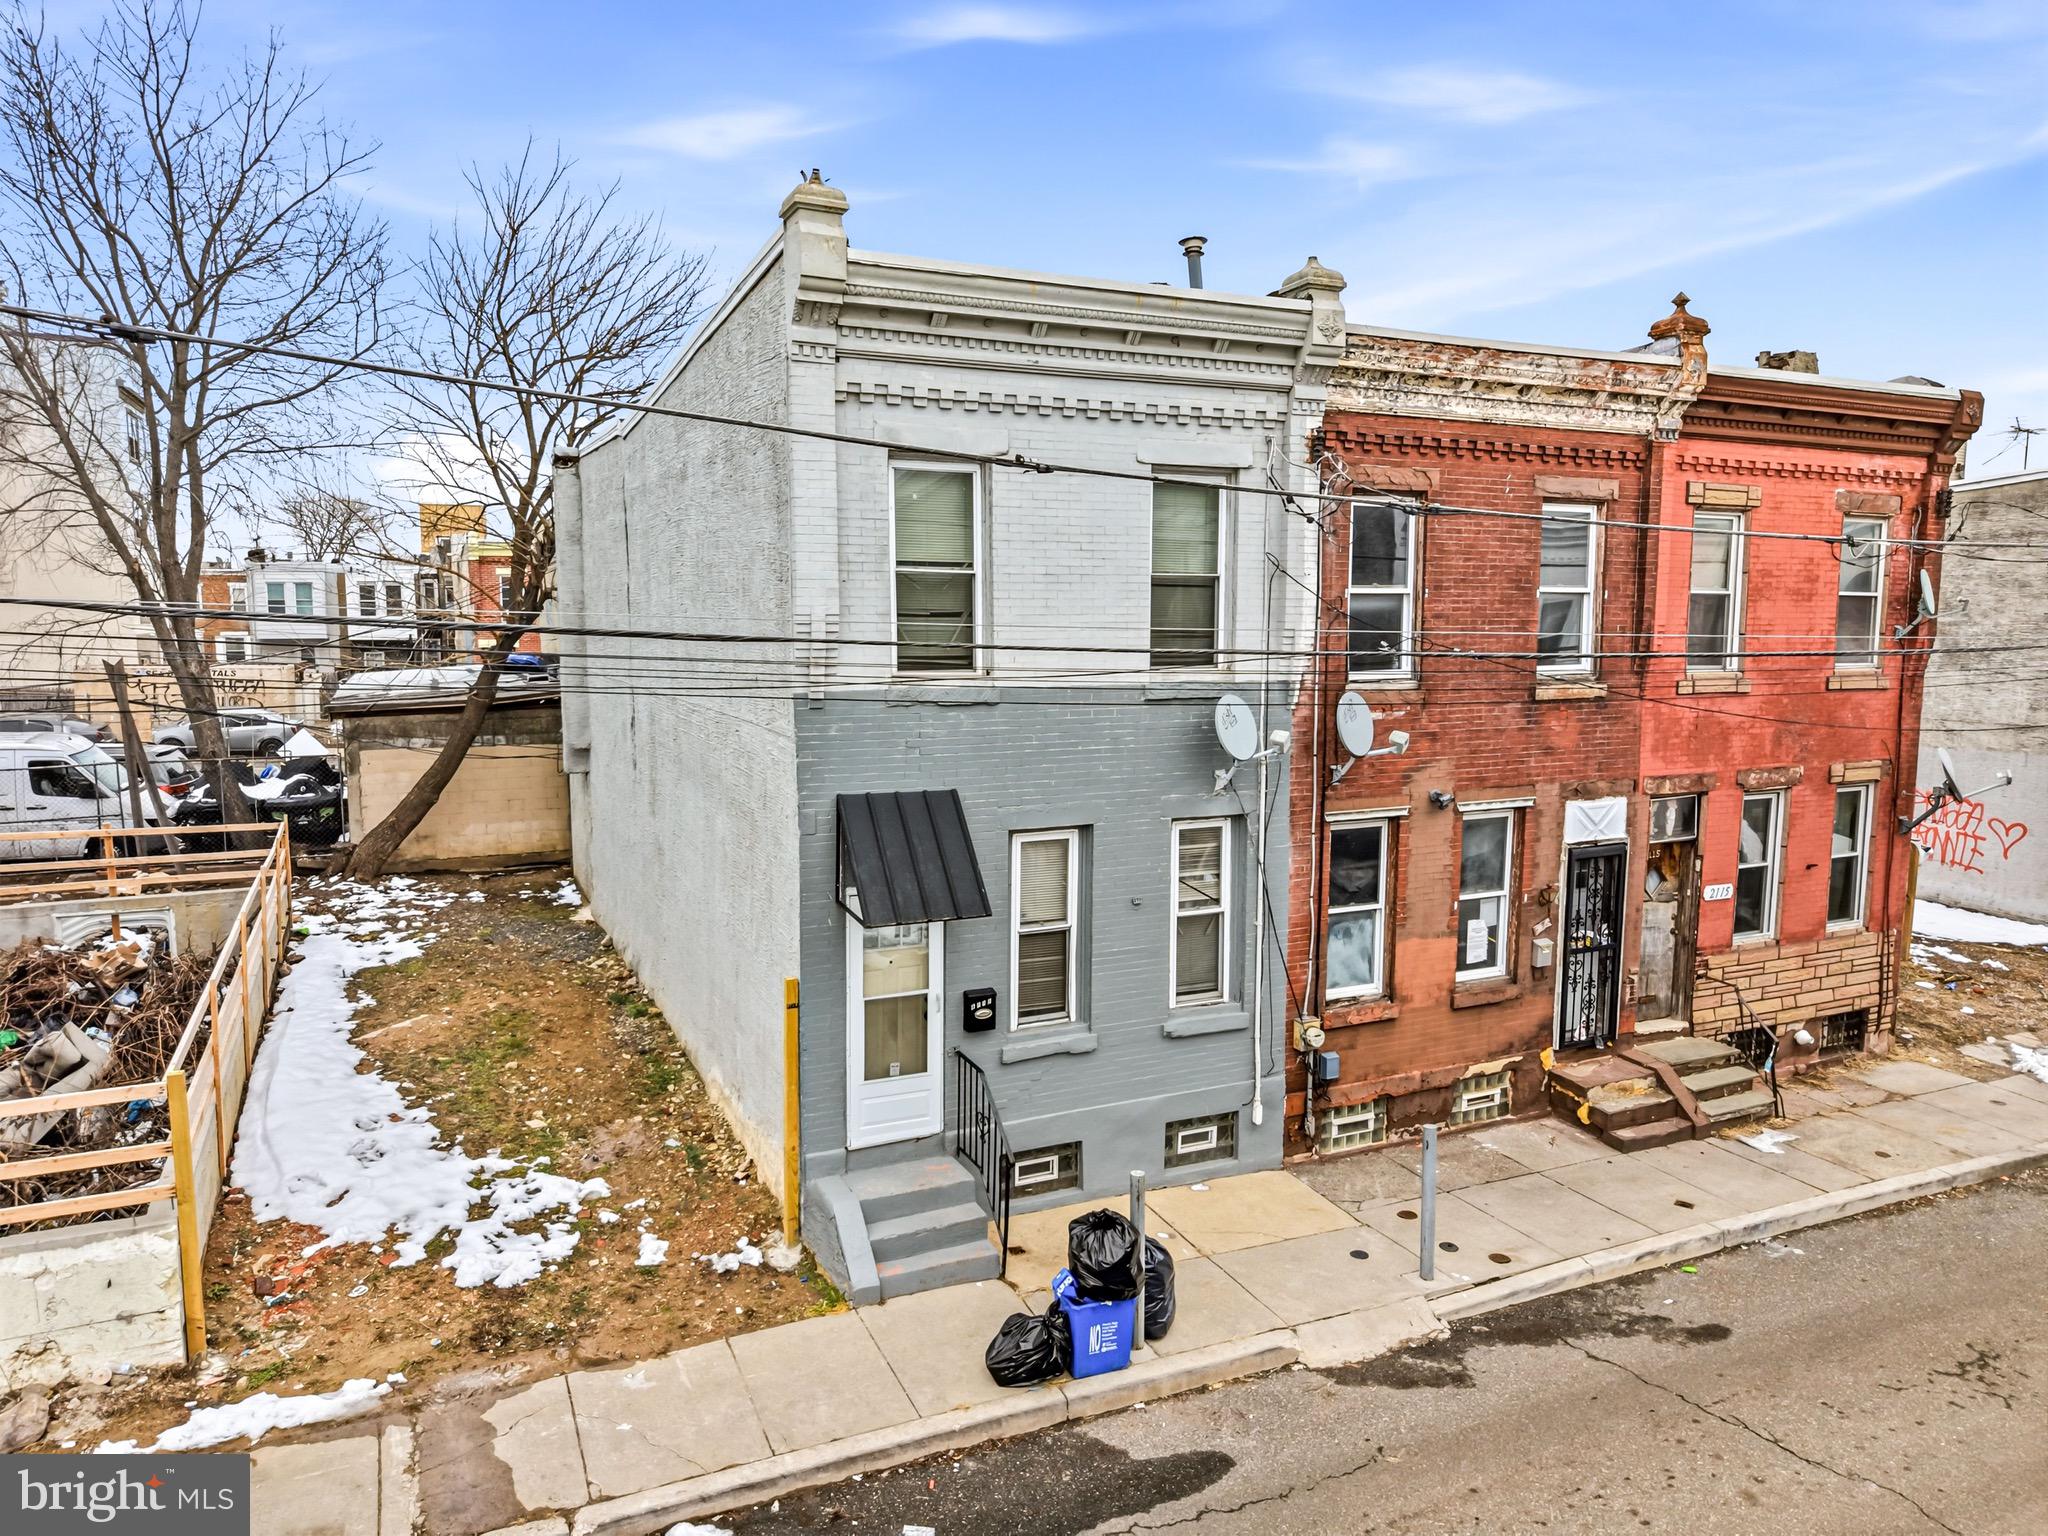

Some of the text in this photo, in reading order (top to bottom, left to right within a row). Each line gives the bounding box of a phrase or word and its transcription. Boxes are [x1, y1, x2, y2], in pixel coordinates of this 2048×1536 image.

[211, 669, 237, 677] TALS
[1709, 886, 1731, 899] 2115
[1089, 1324, 1101, 1352] NO
